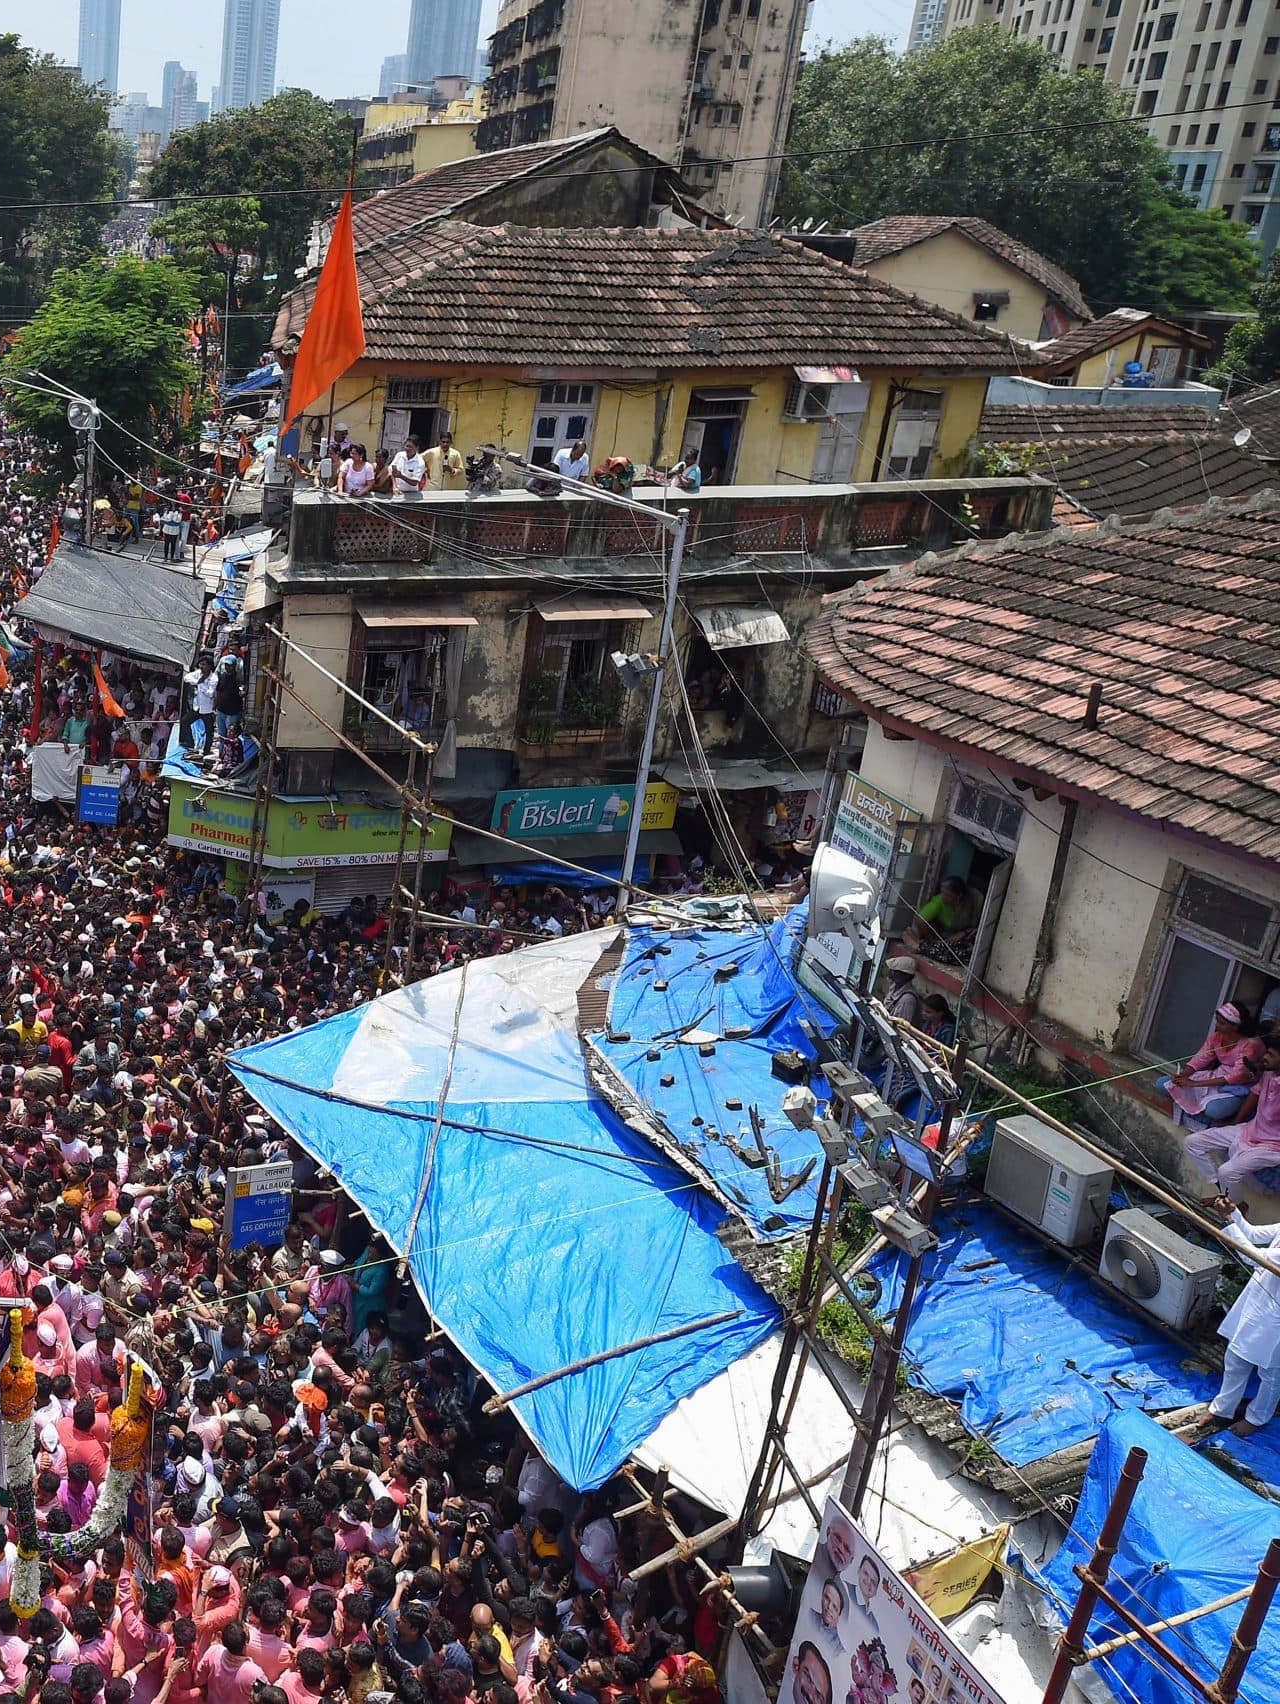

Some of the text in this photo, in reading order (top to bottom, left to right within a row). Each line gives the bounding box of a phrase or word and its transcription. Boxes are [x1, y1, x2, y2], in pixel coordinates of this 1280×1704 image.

[520, 798, 595, 830] Bisleri
[198, 842, 249, 860] Caring for Life
[297, 857, 320, 867] SAVE
[349, 853, 369, 865] 80%
[370, 854, 384, 863] ON
[256, 1180, 289, 1192] LALBAUG
[240, 1219, 285, 1233] GAS COMPANY
[268, 1229, 285, 1238] LANE
[907, 1607, 985, 1703] भारतीय जनता
